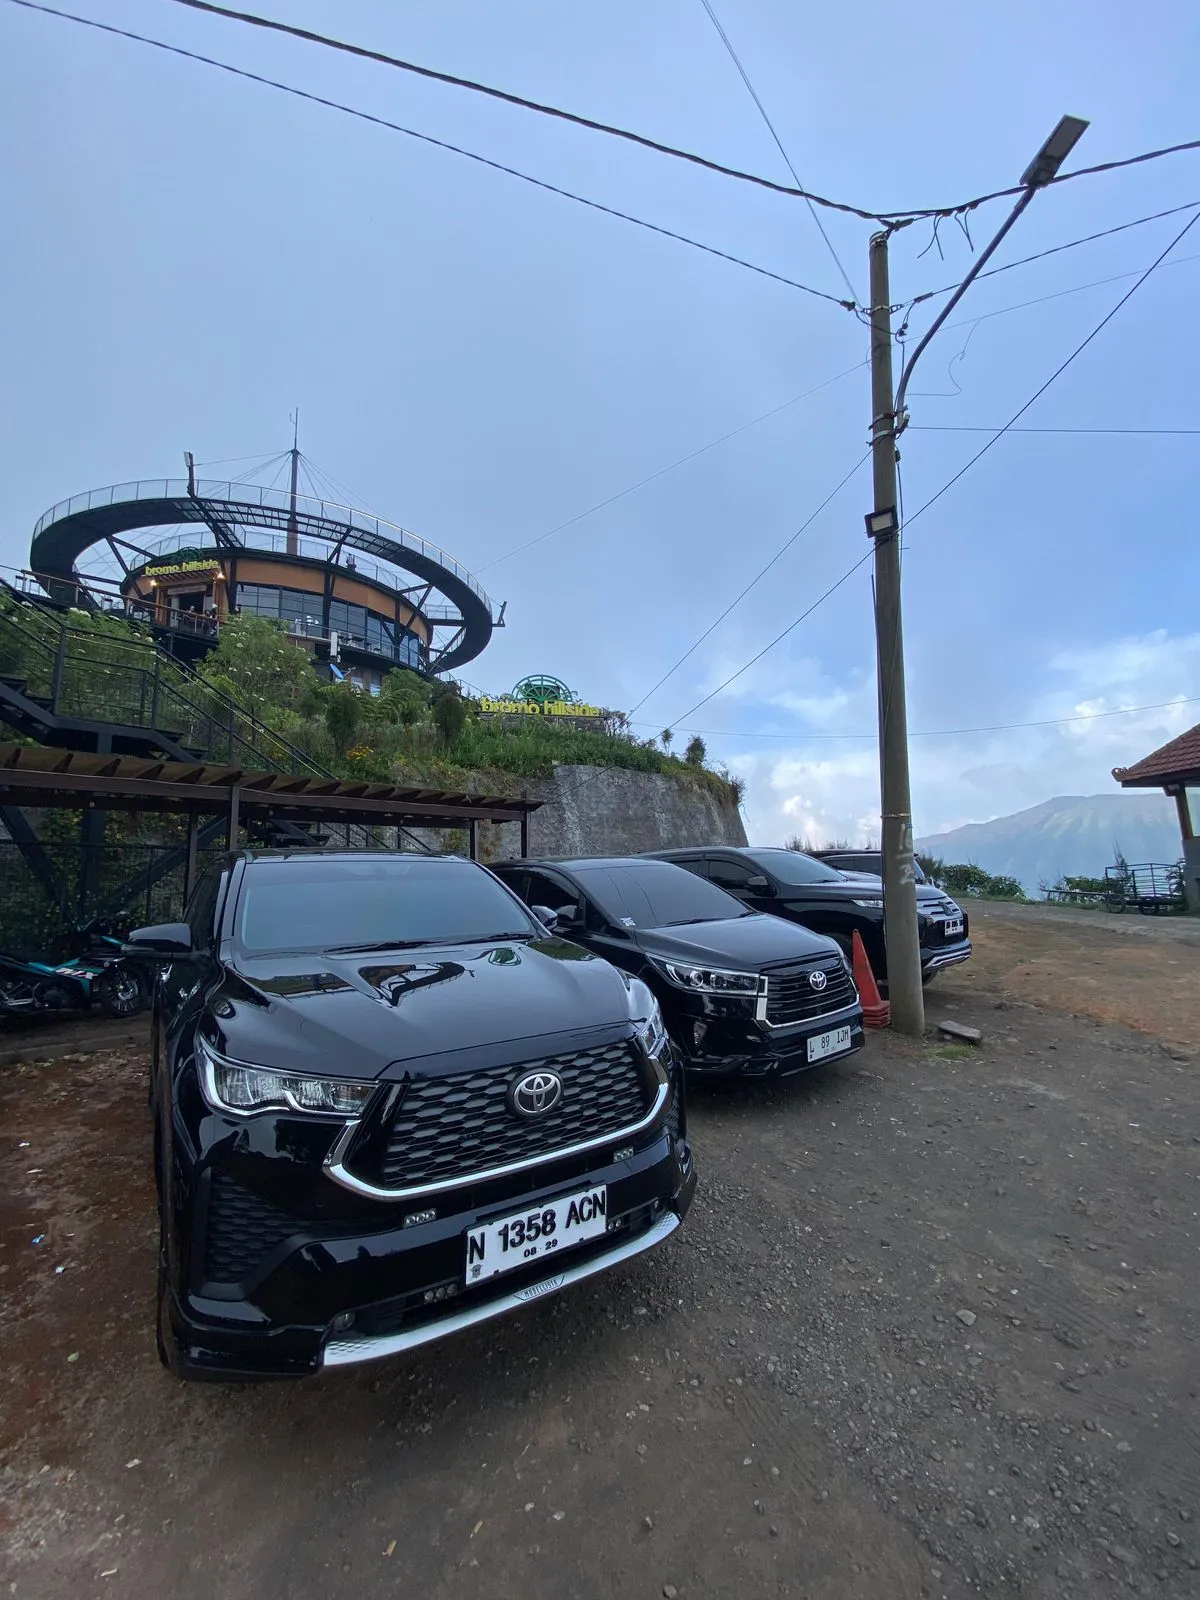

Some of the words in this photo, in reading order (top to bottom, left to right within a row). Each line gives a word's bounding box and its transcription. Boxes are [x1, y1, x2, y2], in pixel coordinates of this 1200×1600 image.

[145, 564, 179, 576] bromo
[182, 559, 219, 571] hillside
[481, 697, 540, 714] bromo
[543, 699, 604, 716] hillside
[809, 1041, 815, 1053] L
[821, 1035, 830, 1049] 89
[468, 1232, 486, 1264] N
[497, 1209, 557, 1252] 1358
[565, 1190, 606, 1229] ACN
[523, 1247, 537, 1258] 08
[545, 1239, 558, 1250] 29
